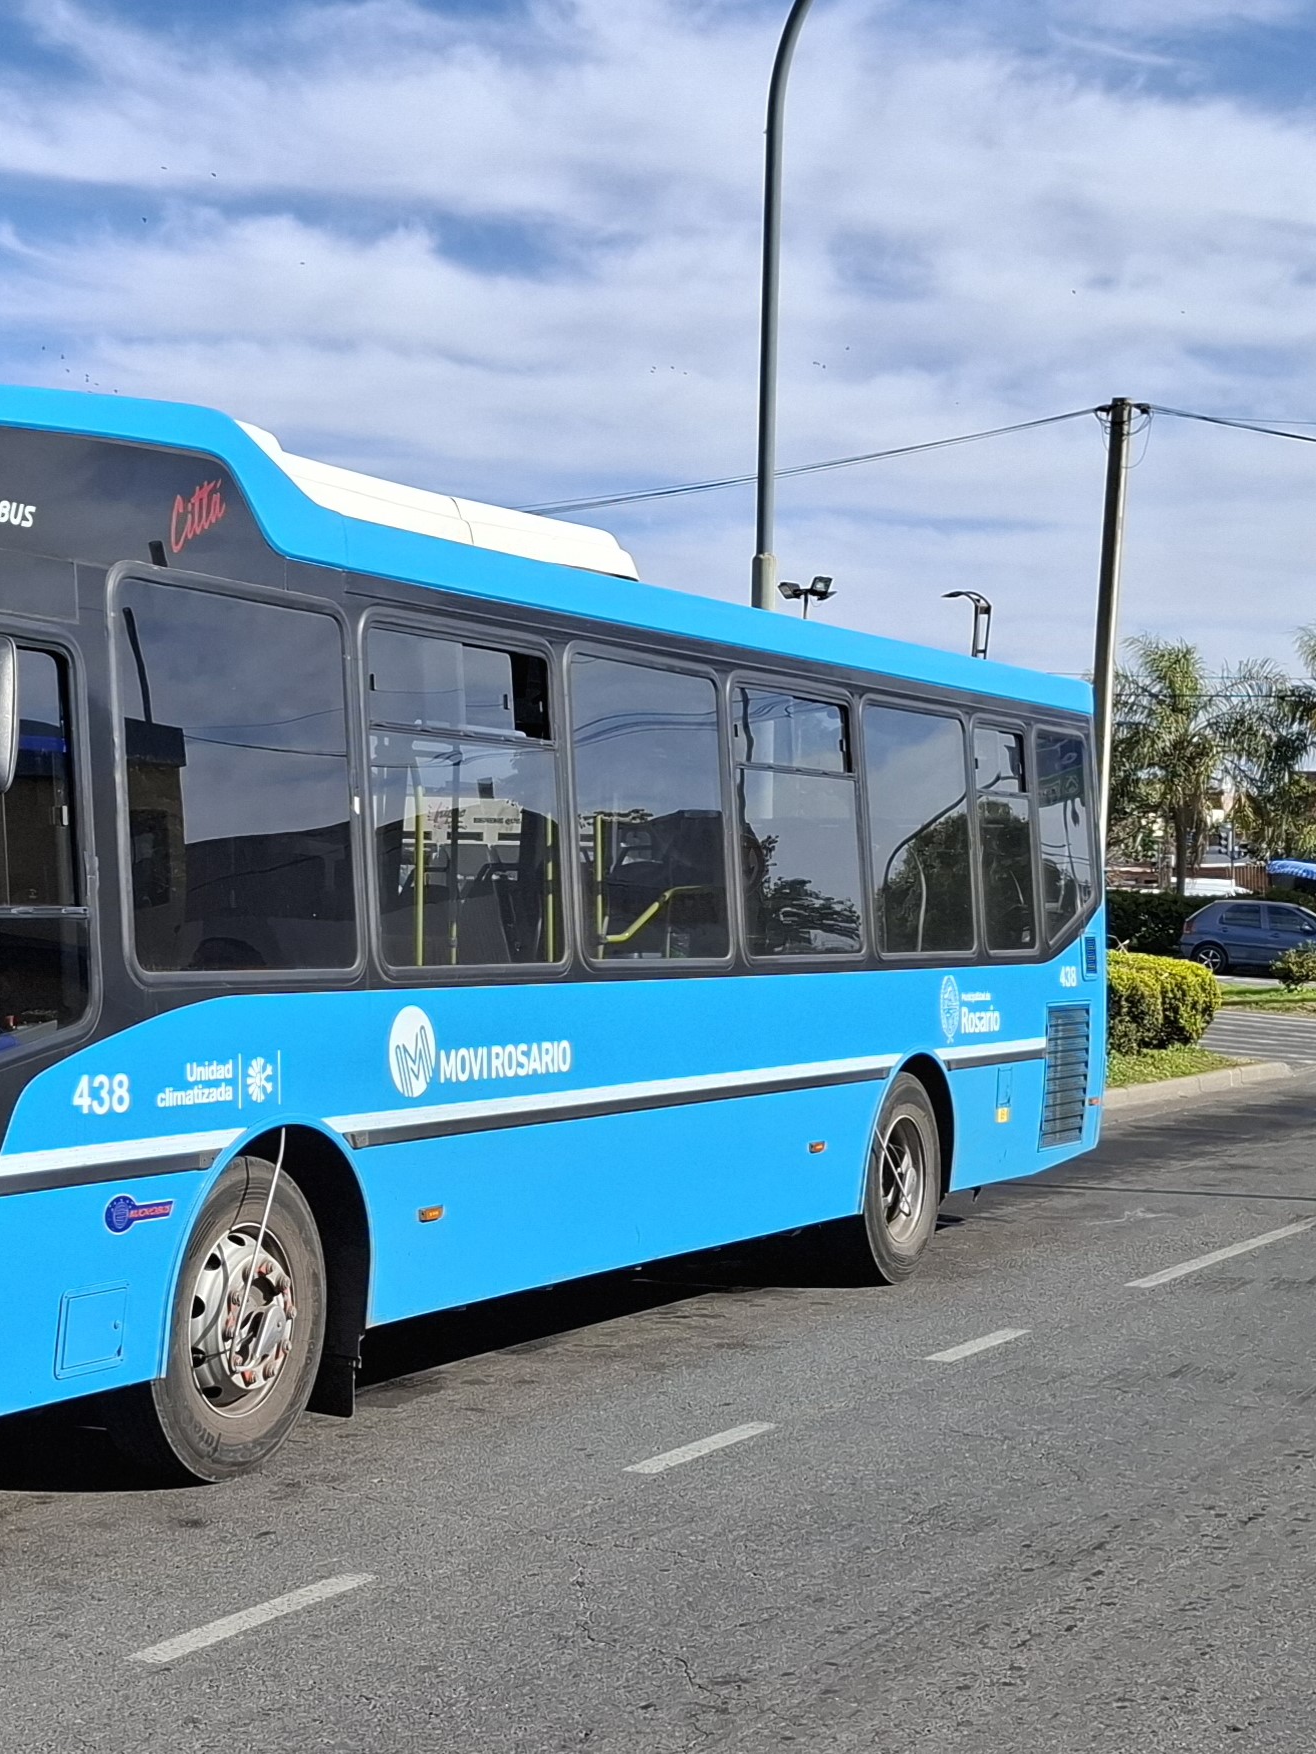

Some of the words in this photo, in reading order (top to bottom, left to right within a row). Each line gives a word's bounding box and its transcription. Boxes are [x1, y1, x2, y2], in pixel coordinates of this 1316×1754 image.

[1059, 965, 1078, 988] 438
[960, 1005, 1001, 1034] Rosario
[186, 1058, 234, 1082] Unidad
[439, 1046, 488, 1084] MOVI
[491, 1039, 572, 1079] ROSARIO
[72, 1072, 131, 1116] 438
[156, 1082, 234, 1109] climatizada
